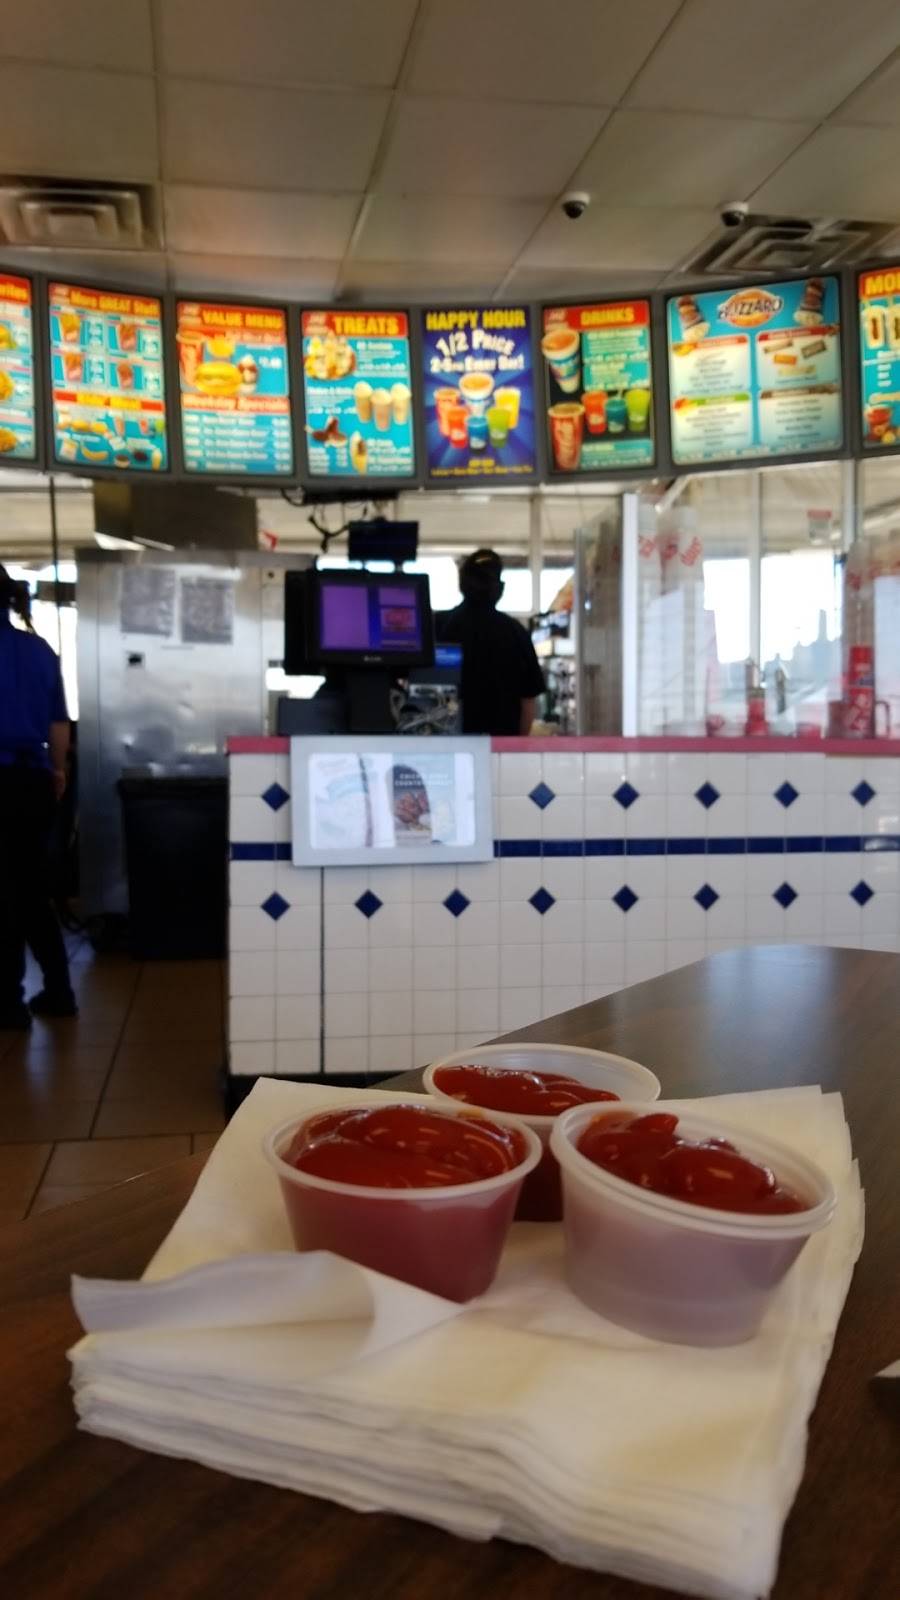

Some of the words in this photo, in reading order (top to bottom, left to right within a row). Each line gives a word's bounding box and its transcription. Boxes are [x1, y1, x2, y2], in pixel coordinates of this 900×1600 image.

[865, 272, 900, 295] MO
[202, 309, 241, 326] VALUE
[245, 313, 283, 329] MENU
[426, 310, 479, 330] HAPPY
[482, 308, 526, 328] HOUR
[580, 307, 635, 326] DRINKS
[717, 295, 783, 322] BLIZZARD
[332, 315, 399, 335] TREATS
[435, 330, 469, 357] 1/2
